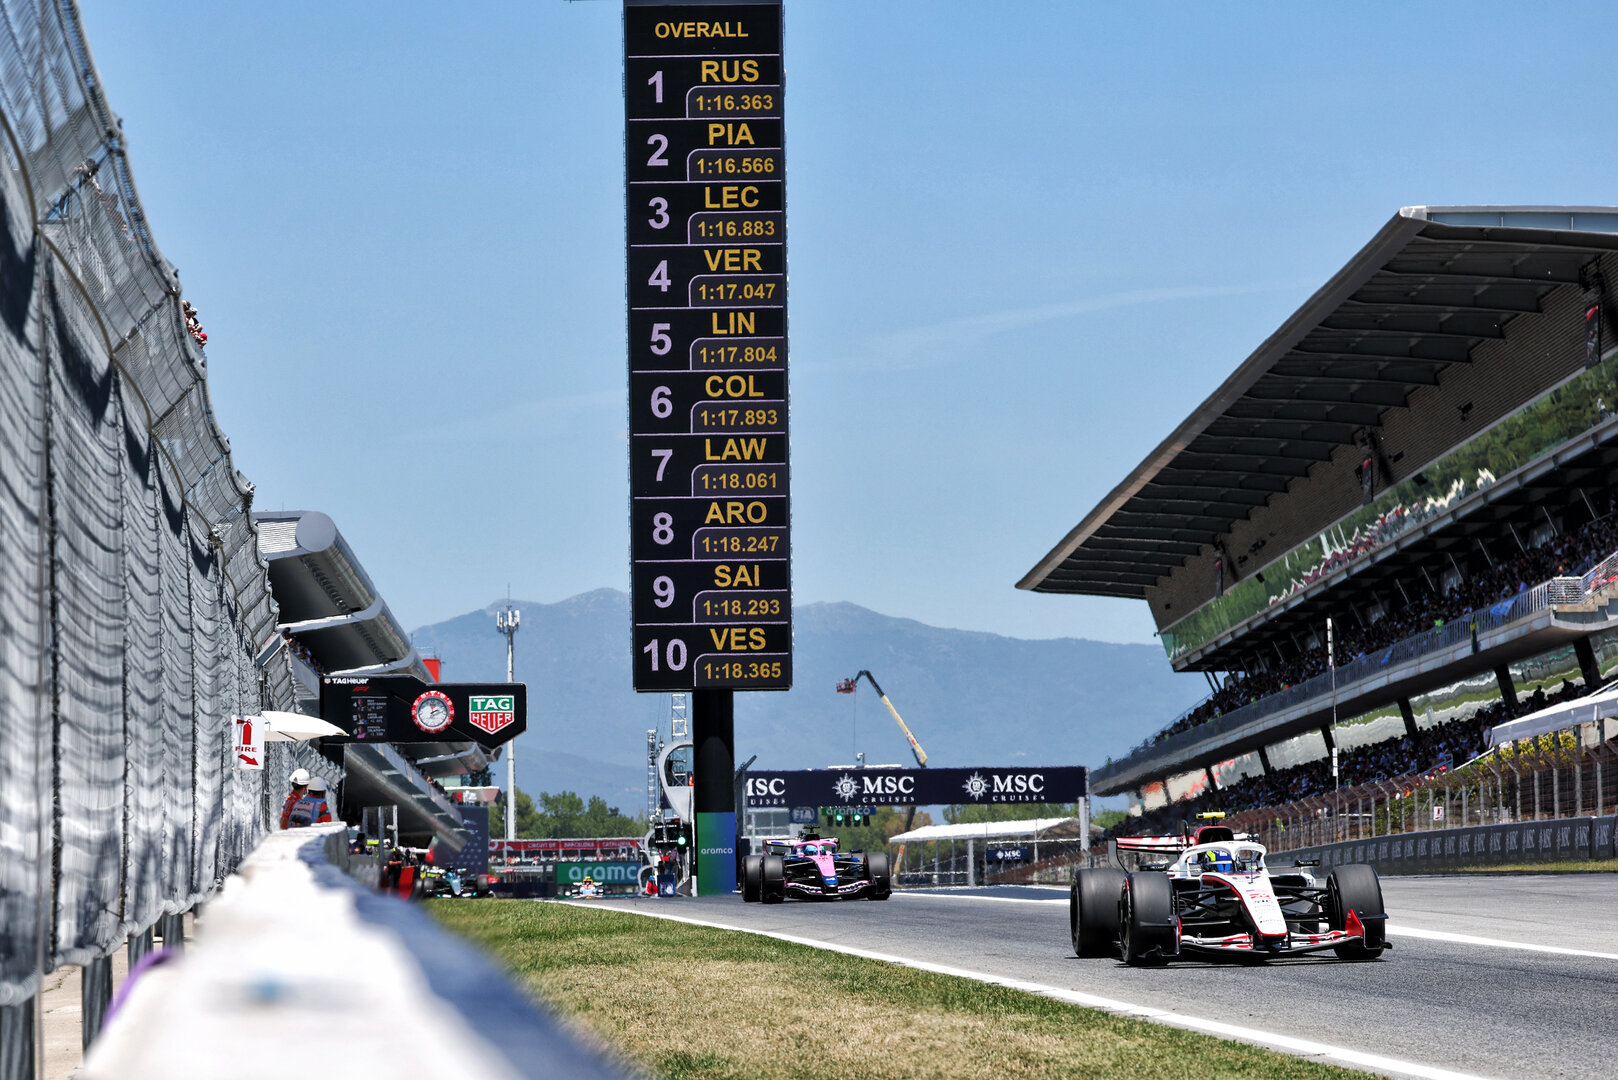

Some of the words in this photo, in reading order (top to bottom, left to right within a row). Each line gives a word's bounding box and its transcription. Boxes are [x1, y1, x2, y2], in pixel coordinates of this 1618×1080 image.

[655, 22, 748, 38] OVERALL
[702, 60, 759, 82] RUS
[647, 70, 663, 103] 1
[697, 95, 773, 110] 1:16.363
[709, 123, 754, 145] PIA
[647, 134, 669, 166] 2
[697, 158, 774, 174] 1:16.566
[705, 186, 759, 208] LEC
[648, 197, 670, 229] 3
[698, 221, 775, 237] 1:16.883
[704, 249, 762, 271] VER
[648, 260, 671, 292] 4
[699, 284, 776, 300] 1:17.047
[712, 312, 755, 334] LIN
[650, 323, 672, 355] 5
[700, 347, 777, 363] 1:17.804
[705, 375, 764, 398] COL
[651, 386, 673, 418] 6
[701, 410, 778, 426] 1:17.893
[705, 438, 766, 460] LAW
[652, 449, 673, 482] 7
[701, 473, 777, 489] 1:18.061
[705, 501, 767, 524] ARO
[653, 512, 674, 545] 8
[702, 536, 779, 552] 1:18.247
[714, 564, 760, 587] SAI
[653, 576, 675, 608] 9
[703, 600, 780, 616] 1:18.293
[710, 628, 766, 650] VES
[643, 639, 688, 672] 10
[704, 663, 781, 679] 1:18.365
[473, 699, 510, 710] TAG
[472, 713, 512, 731] HEUER
[863, 776, 915, 794] MSC
[992, 774, 1044, 792] MSC
[792, 809, 815, 820] FIA
[826, 806, 871, 816] aramco
[701, 847, 733, 855] aramco
[1004, 850, 1021, 858] MSC
[568, 866, 637, 880] aramc
